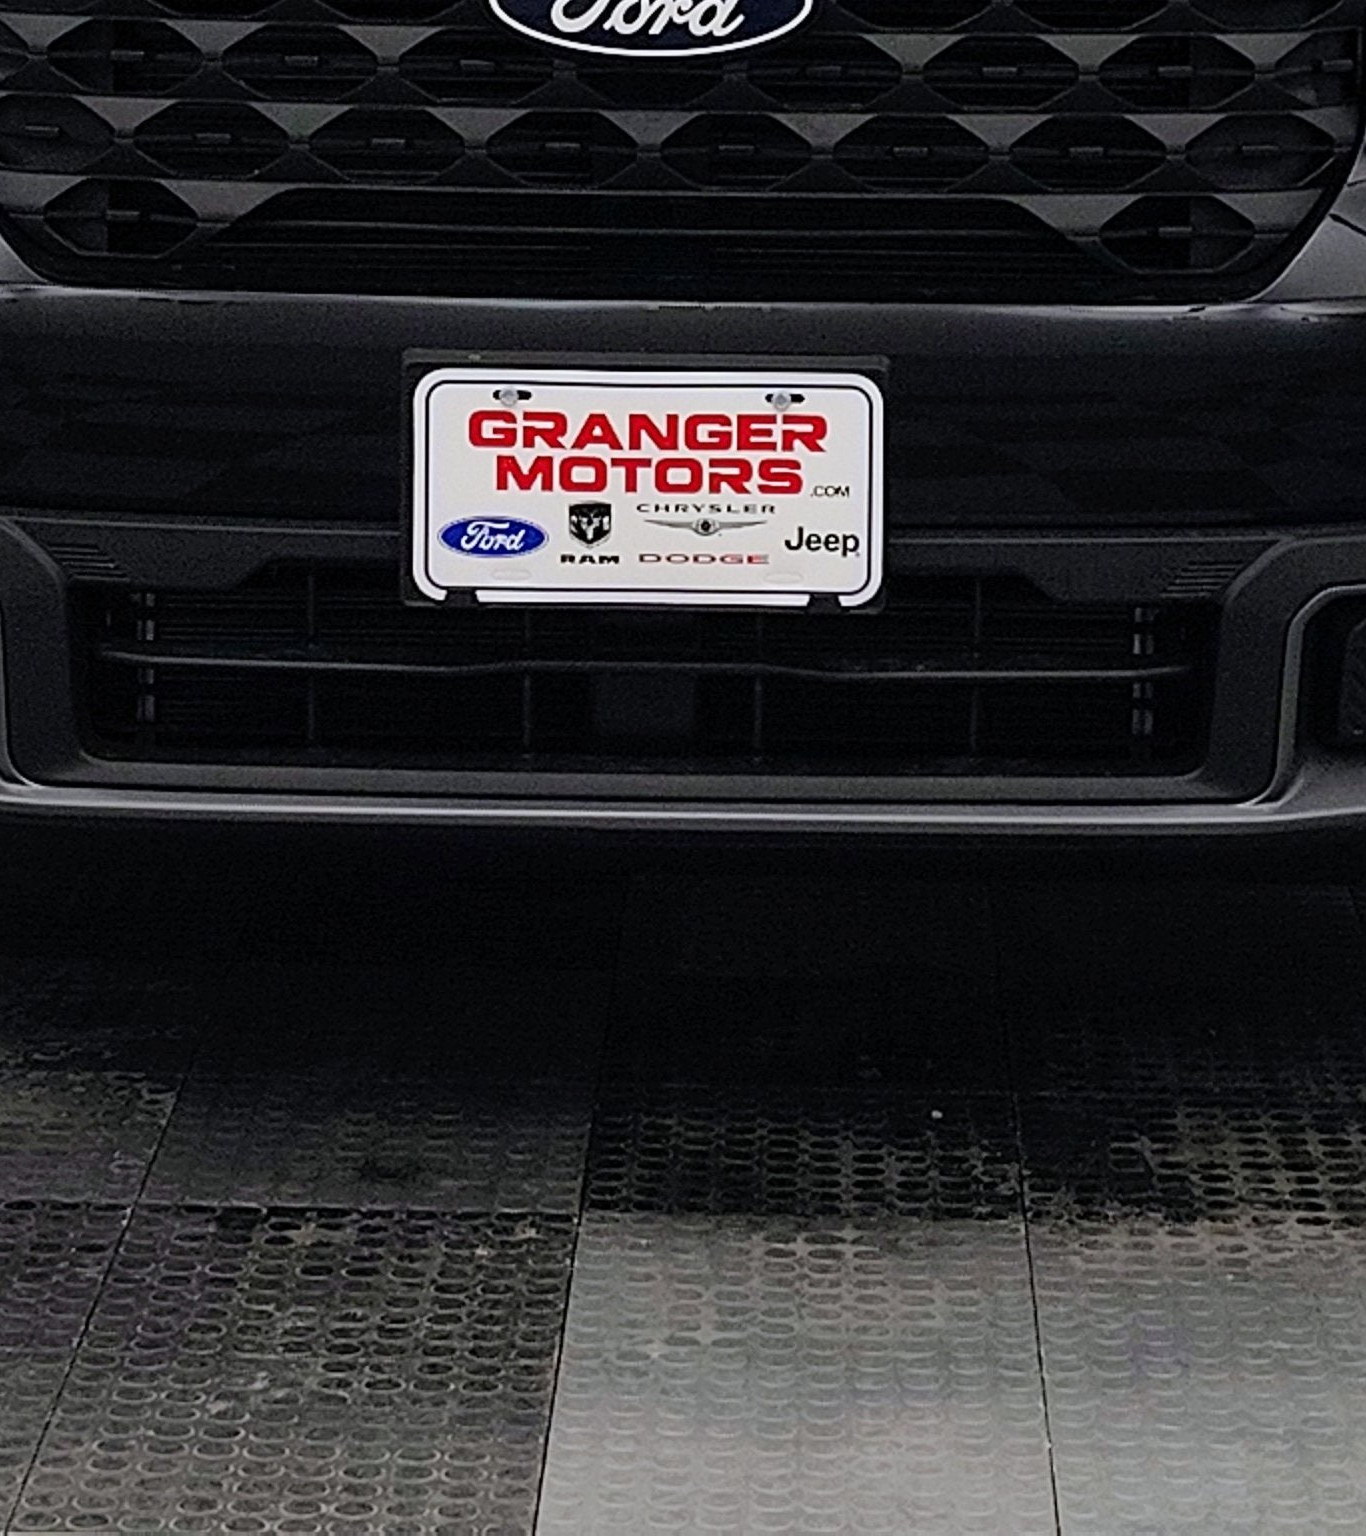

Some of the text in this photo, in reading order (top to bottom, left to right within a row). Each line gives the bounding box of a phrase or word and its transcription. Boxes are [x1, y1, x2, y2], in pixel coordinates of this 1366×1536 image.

[468, 410, 828, 453] GRANGER
[496, 456, 803, 495] MOTORS
[636, 503, 776, 514] CHRYSLER
[460, 520, 526, 551] Ford
[784, 526, 860, 557] Jeep
[560, 553, 620, 564] RAM
[638, 553, 770, 565] DODGE
